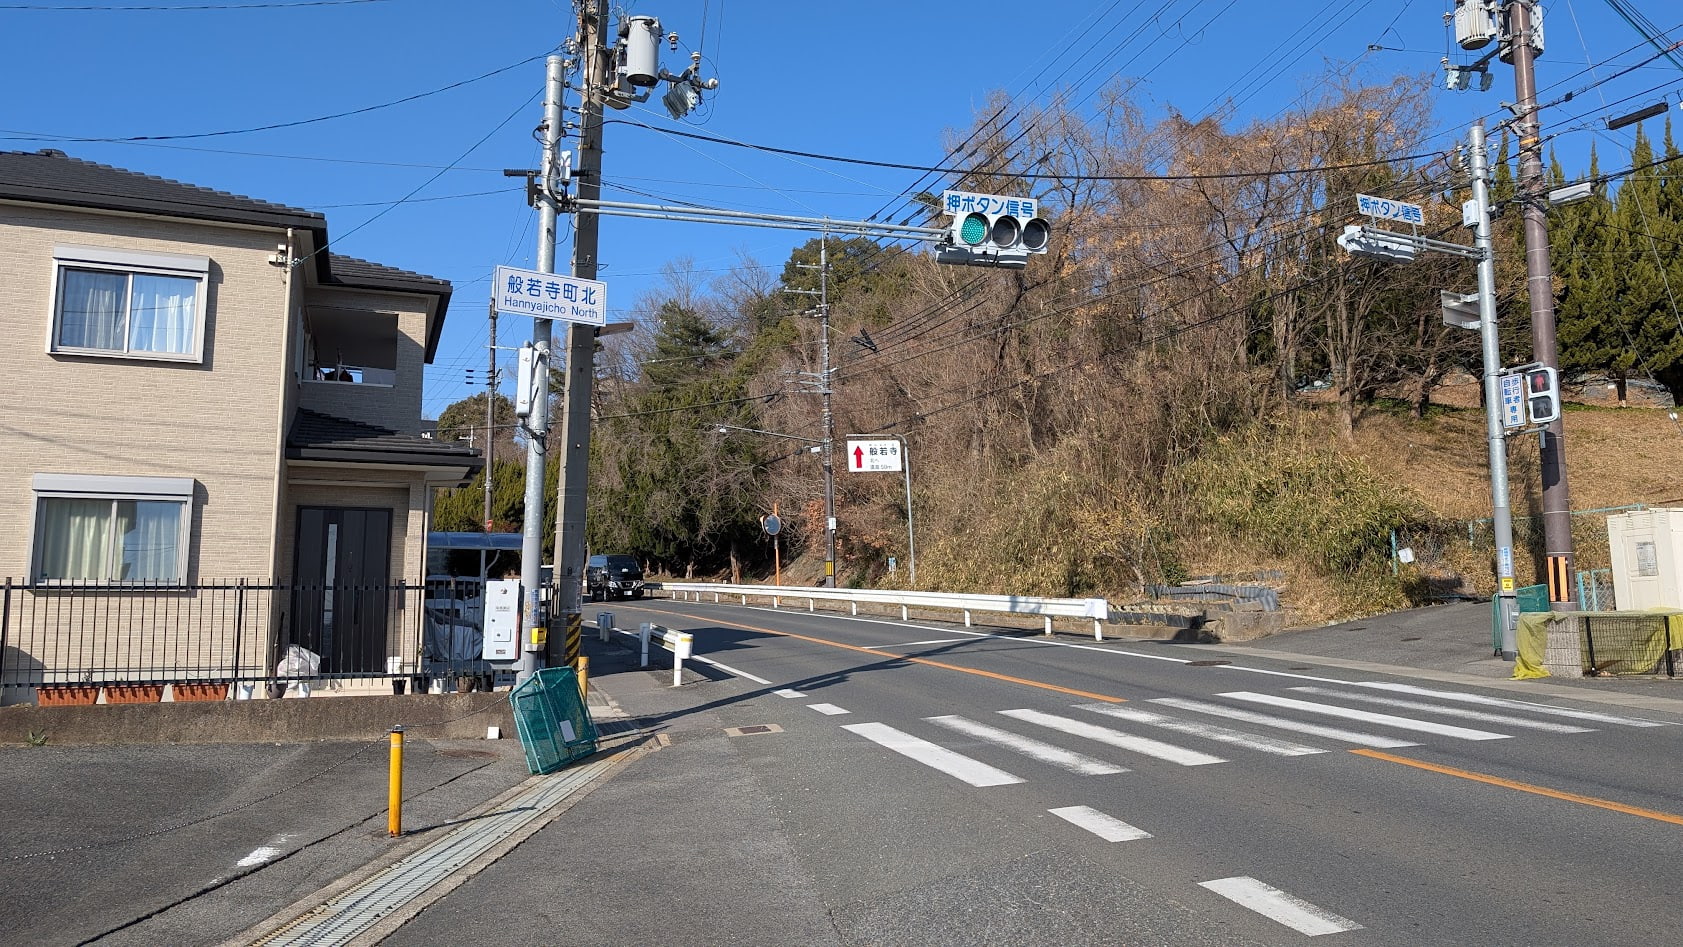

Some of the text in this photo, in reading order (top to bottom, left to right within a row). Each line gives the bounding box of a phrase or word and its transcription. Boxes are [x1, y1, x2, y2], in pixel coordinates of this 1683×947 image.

[946, 193, 1034, 218] 押ボタン信号
[1359, 196, 1422, 223] 押ボタン信号
[507, 274, 597, 306] 般若寺町北
[504, 295, 598, 319] Hannyajicho North
[1503, 379, 1513, 405] 自転車
[1511, 377, 1521, 404] 歩行者
[1510, 405, 1519, 424] 専用
[869, 447, 898, 456] 般若寺
